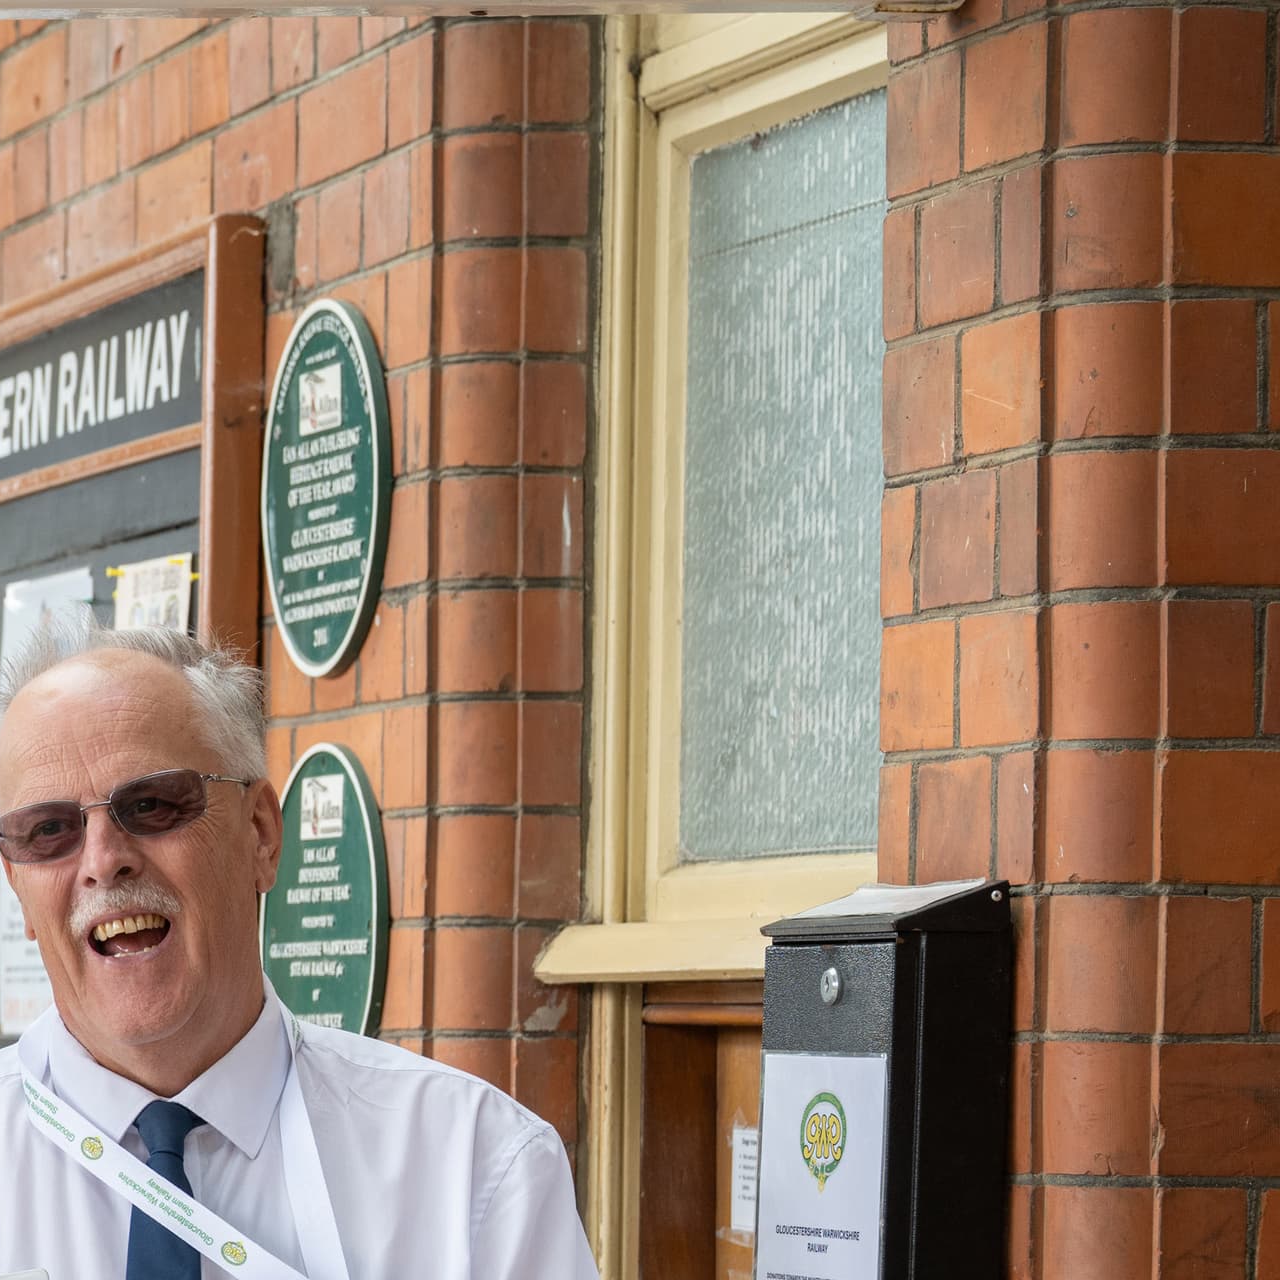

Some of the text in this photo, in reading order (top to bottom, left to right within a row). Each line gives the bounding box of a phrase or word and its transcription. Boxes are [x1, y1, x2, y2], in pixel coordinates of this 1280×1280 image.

[56, 310, 190, 438] RAILWAY
[118, 1171, 214, 1246] Gloucestershire Warwickshire
[147, 1178, 194, 1217] Steam Railway
[775, 1224, 860, 1241] GLOUCESTERSHIRE WARWICKSHIRE
[807, 1242, 828, 1254] RAILWAY
